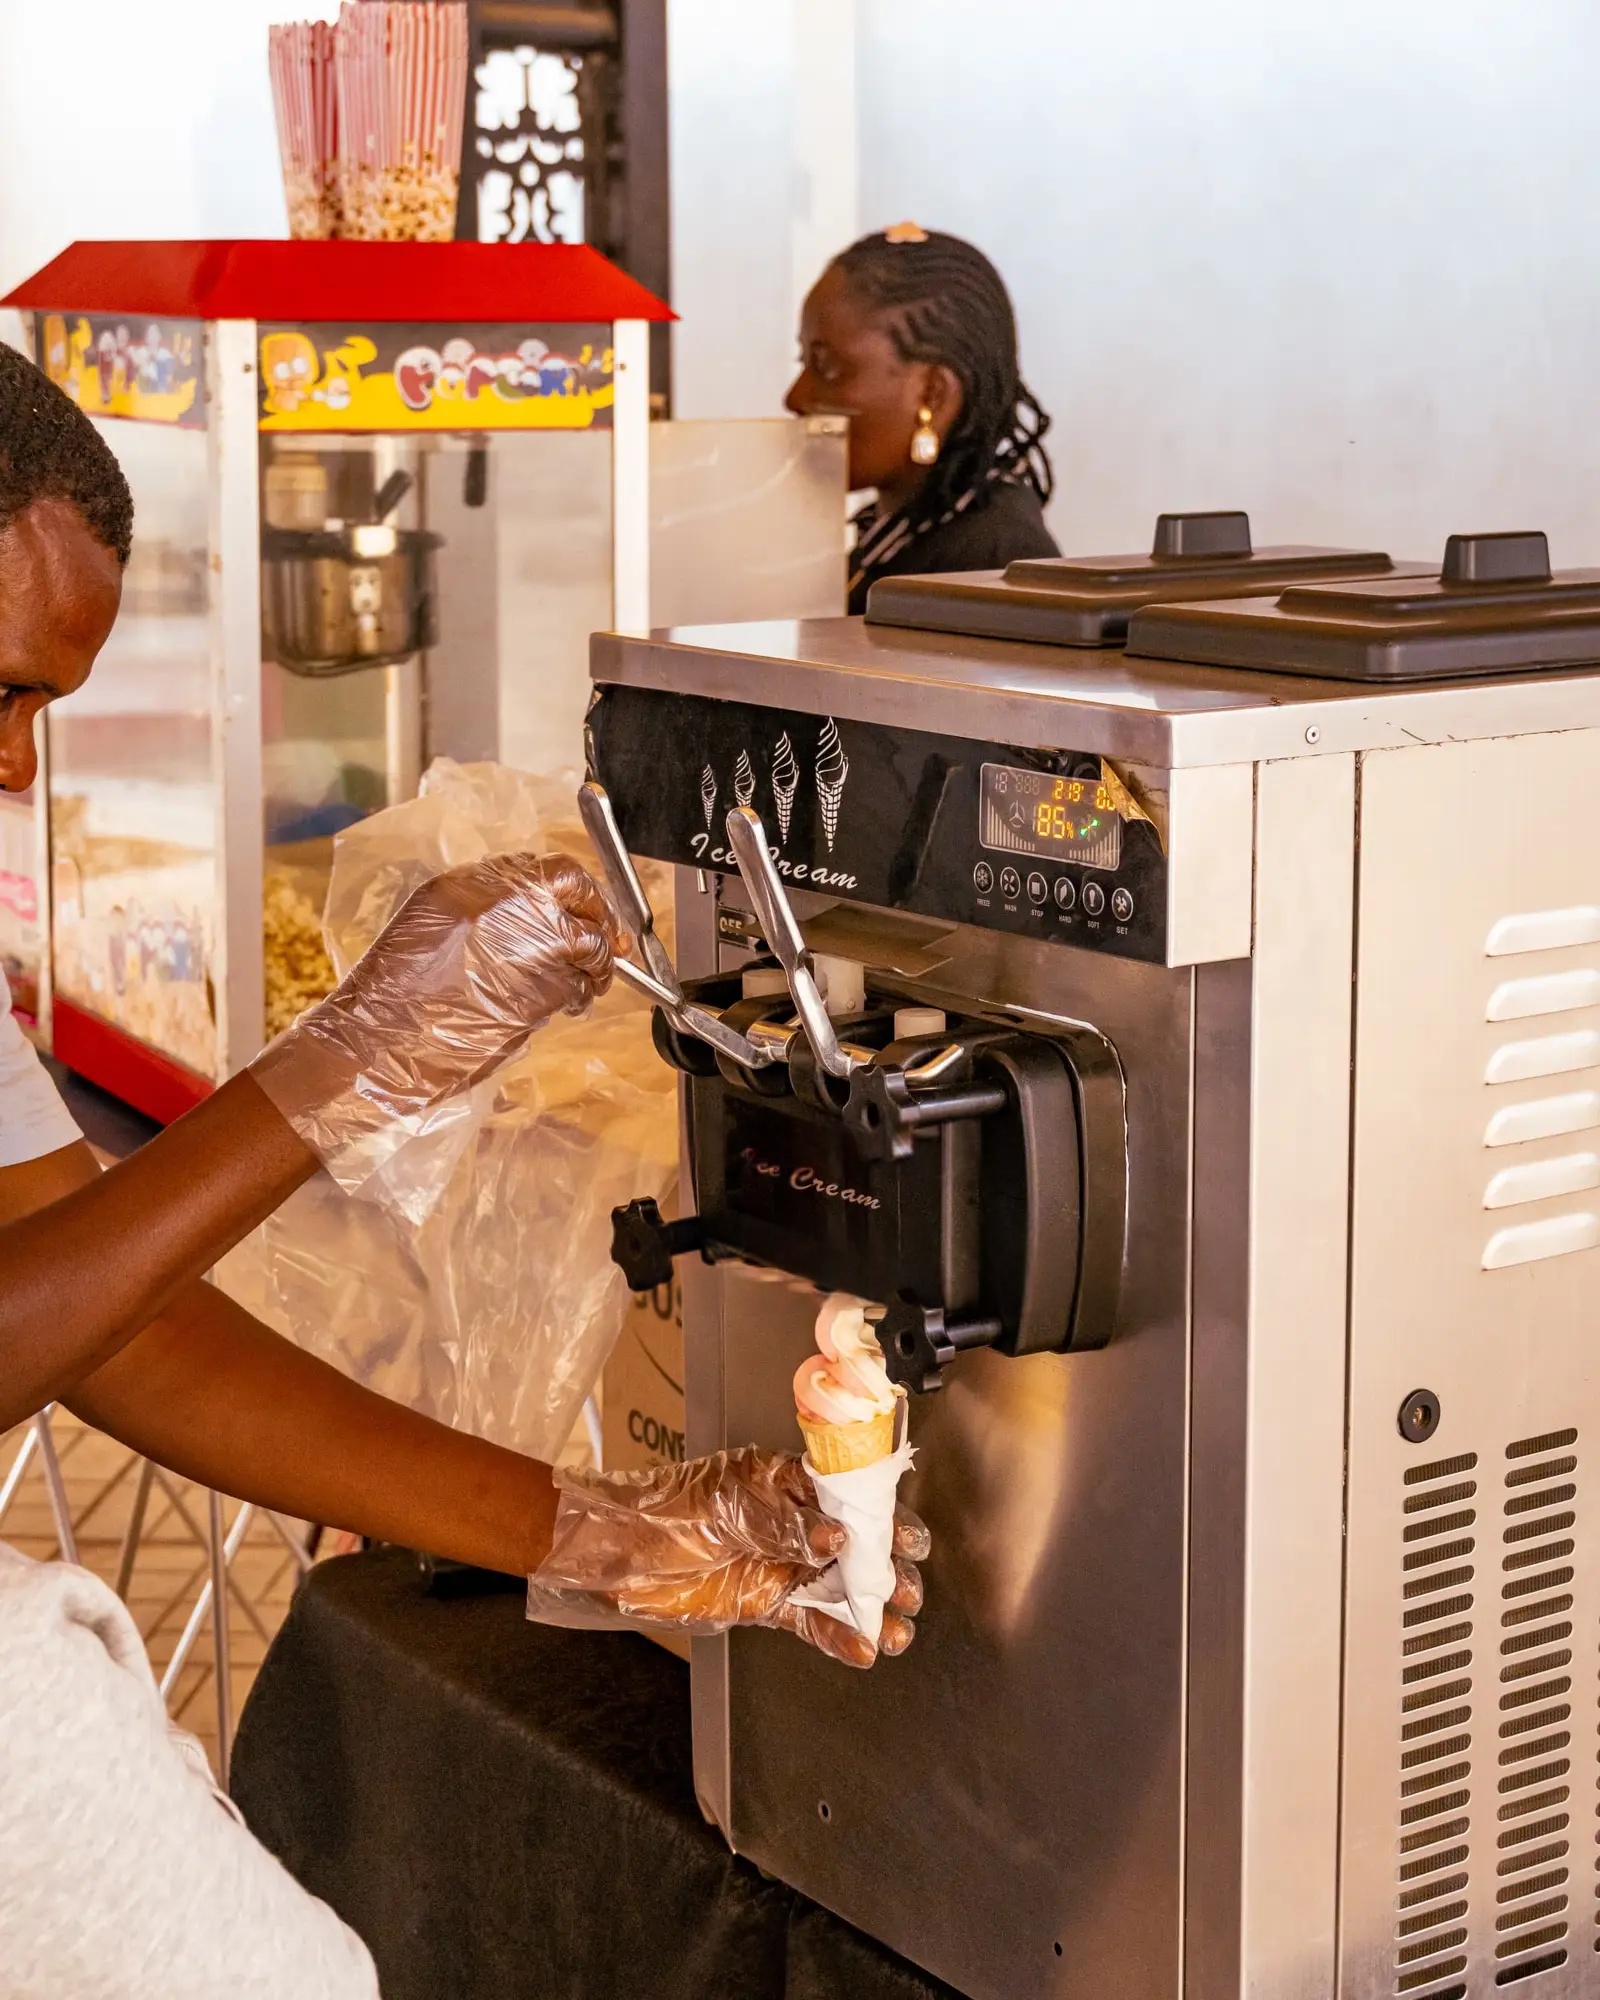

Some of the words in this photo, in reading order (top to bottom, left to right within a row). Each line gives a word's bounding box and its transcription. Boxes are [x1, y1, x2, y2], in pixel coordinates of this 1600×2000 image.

[1004, 904, 1017, 912] WASH
[1031, 909, 1044, 918] STOP
[1058, 915, 1072, 924] HARD
[1087, 920, 1100, 929] SOFT
[1116, 926, 1128, 935] SET
[789, 1167, 881, 1210] Cream
